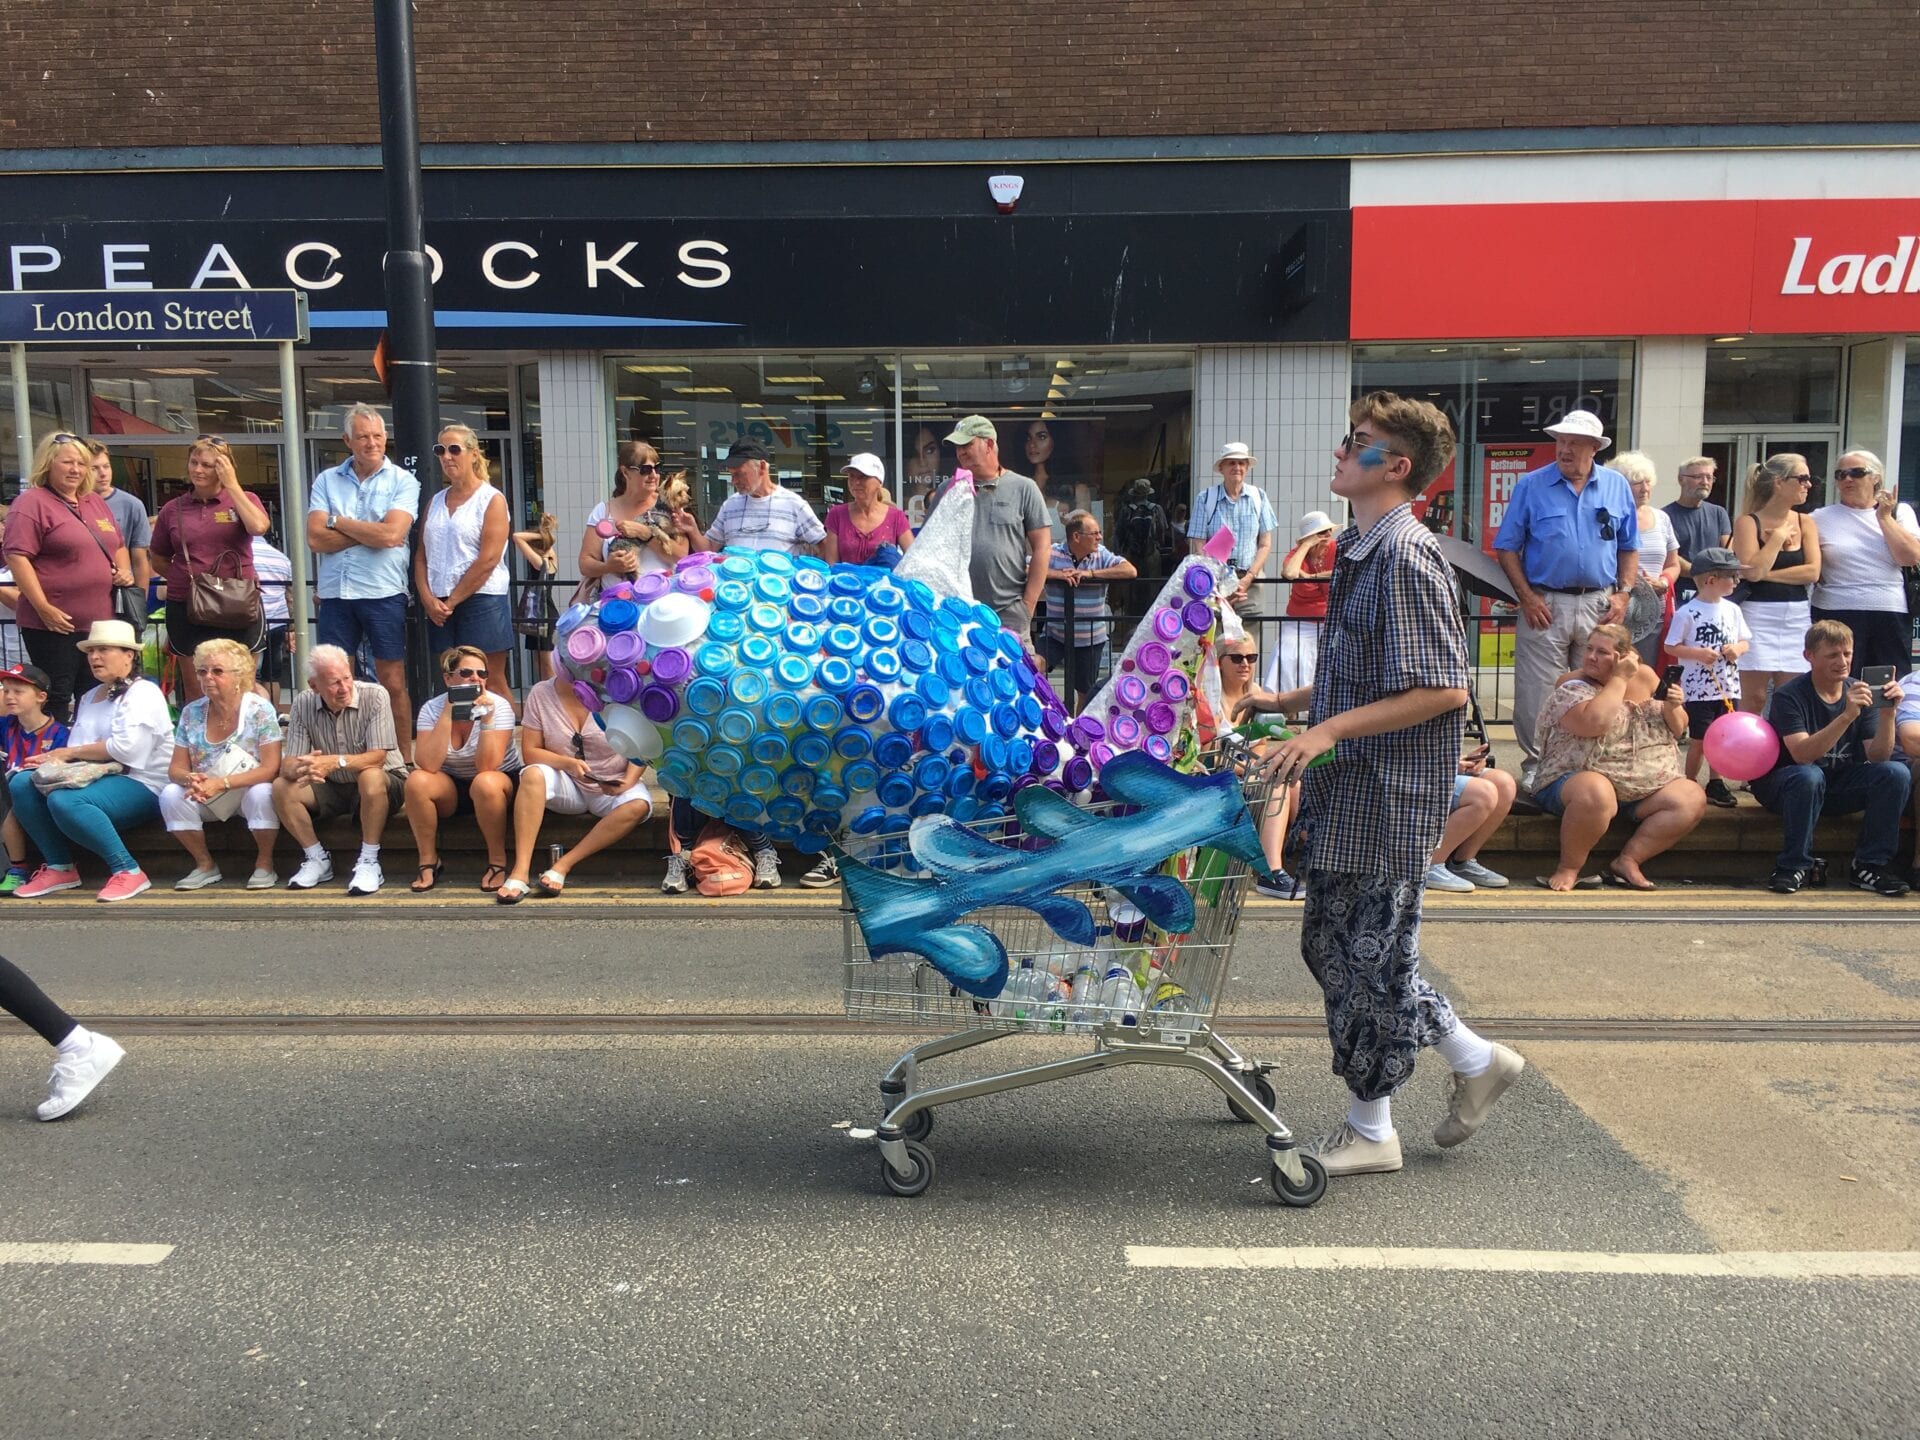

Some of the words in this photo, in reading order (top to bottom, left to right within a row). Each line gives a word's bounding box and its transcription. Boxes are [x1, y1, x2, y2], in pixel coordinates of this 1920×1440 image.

[32, 302, 155, 331] London
[164, 302, 252, 331] Street
[404, 456, 418, 466] CF
